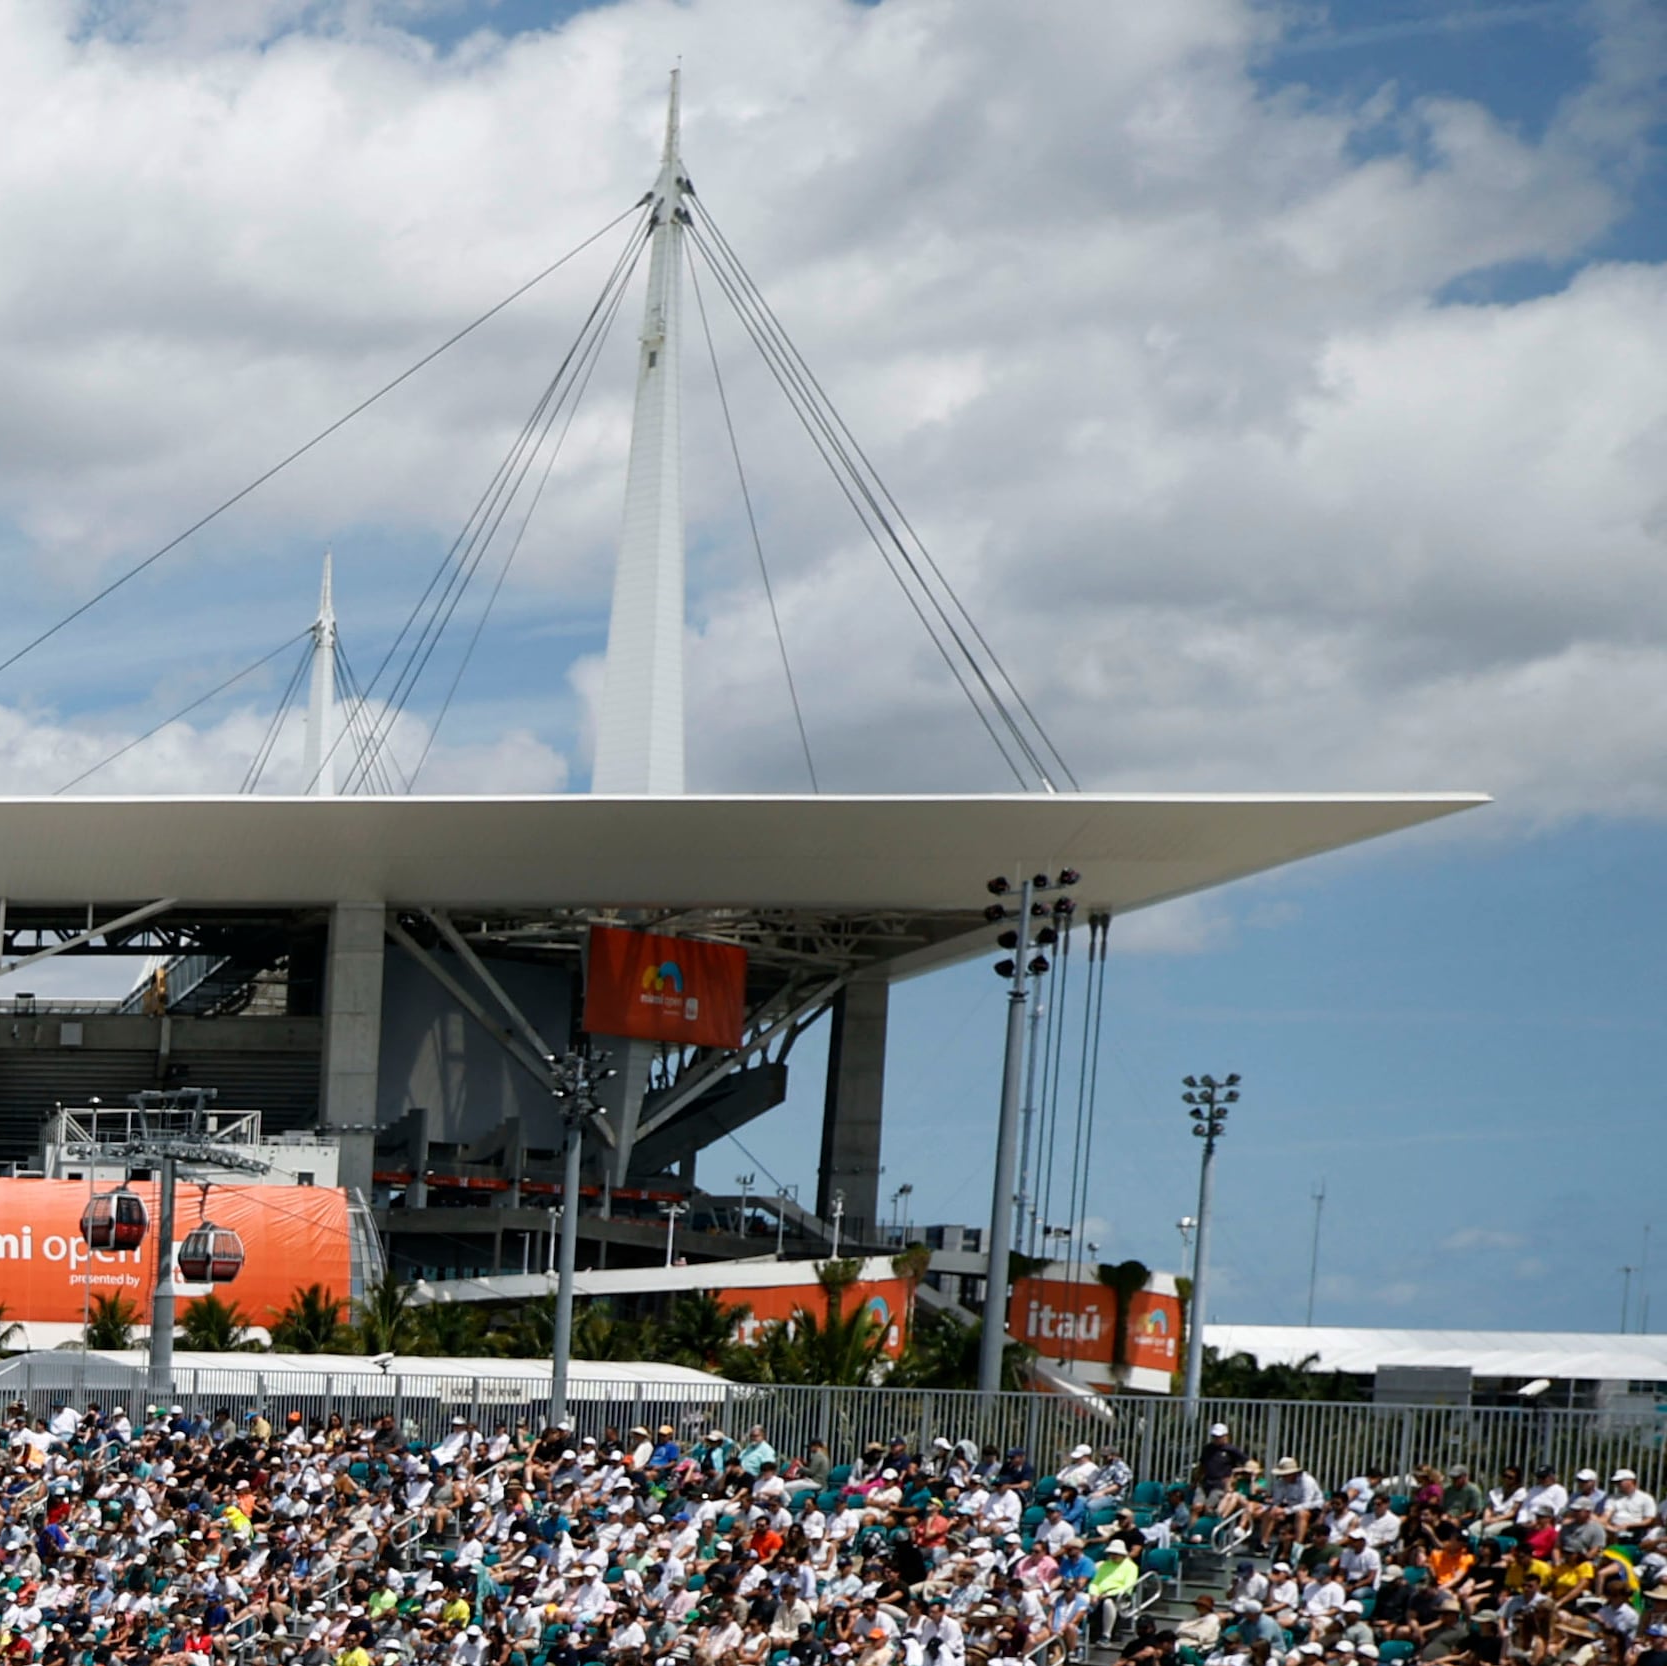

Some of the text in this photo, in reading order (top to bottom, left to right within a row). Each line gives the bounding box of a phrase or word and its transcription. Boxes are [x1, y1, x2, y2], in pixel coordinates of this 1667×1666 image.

[69, 1273, 140, 1287] presented by
[1028, 1301, 1100, 1340] itaú
